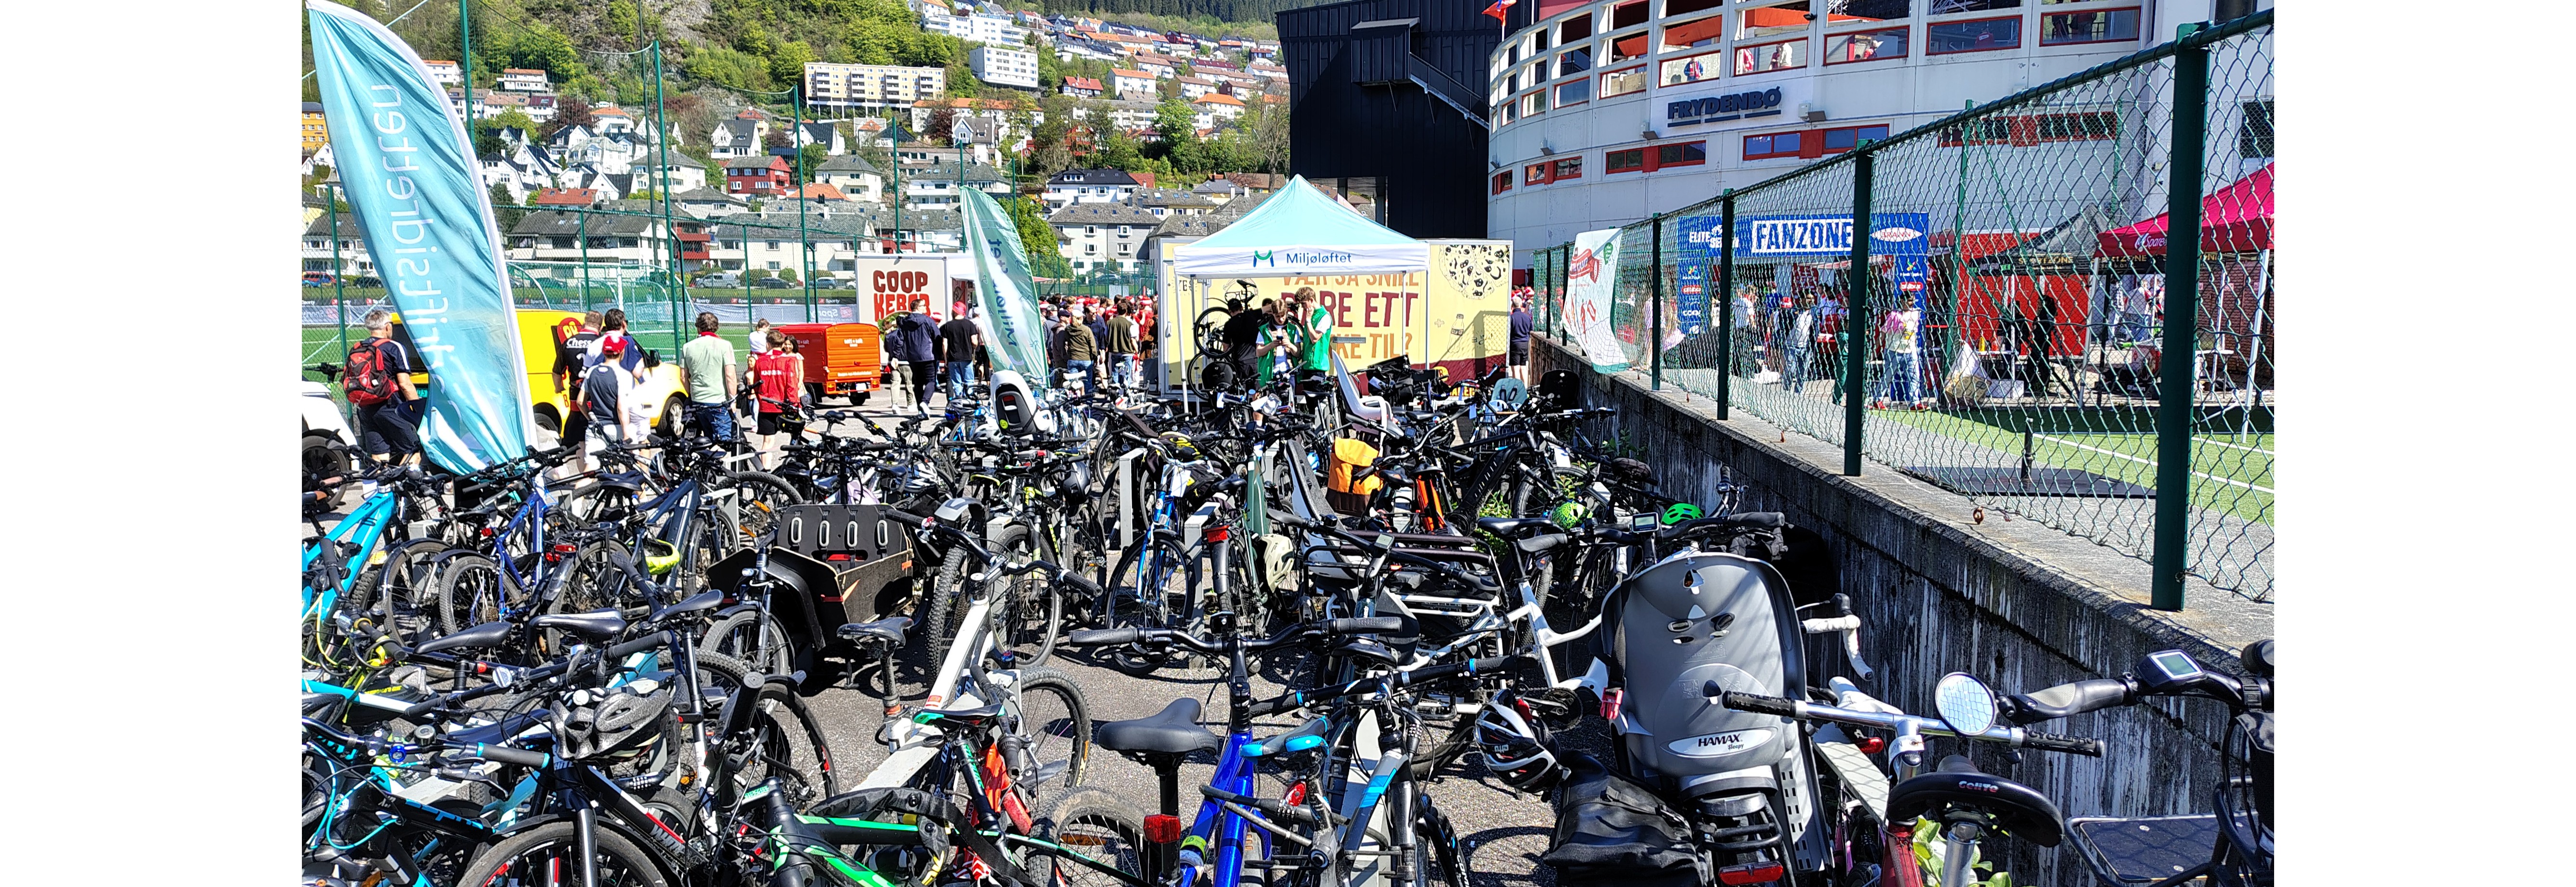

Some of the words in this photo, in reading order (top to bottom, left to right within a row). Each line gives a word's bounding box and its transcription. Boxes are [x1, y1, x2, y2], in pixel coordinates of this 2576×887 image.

[1667, 86, 1782, 119] FRYDENBØ
[1756, 222, 1851, 249] FANZONE
[1287, 252, 1352, 266] Miljøløftet
[1365, 291, 1418, 327] ETT
[1698, 733, 1741, 747] HAMAX
